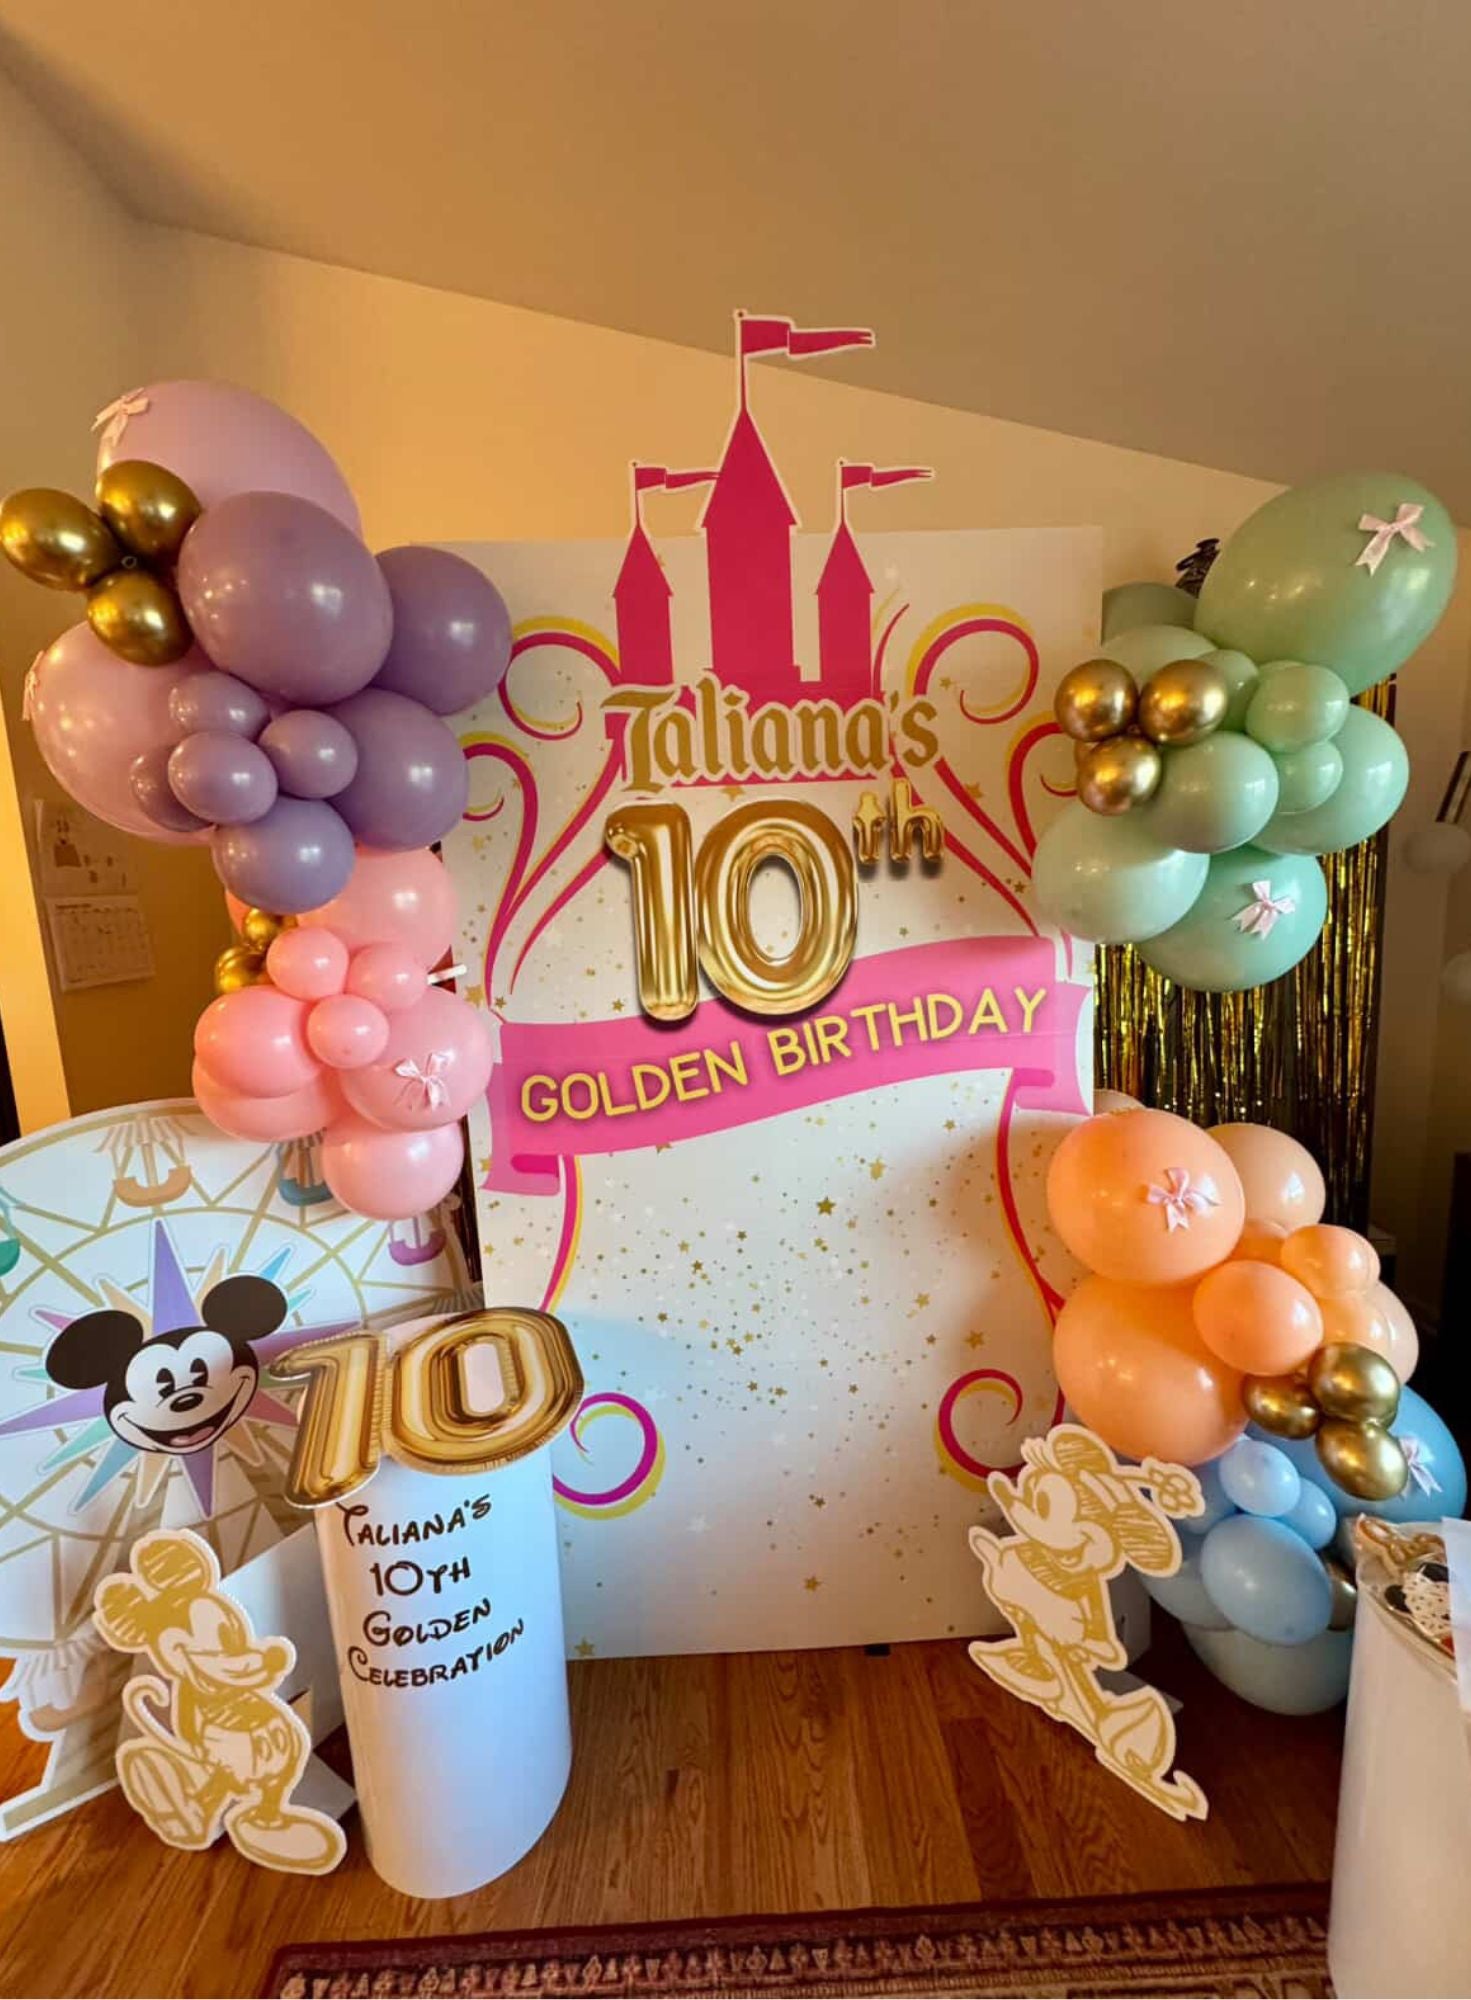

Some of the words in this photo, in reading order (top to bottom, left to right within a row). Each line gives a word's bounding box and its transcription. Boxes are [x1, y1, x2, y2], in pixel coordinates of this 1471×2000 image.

[601, 672, 940, 793] Taliana's
[520, 1040, 749, 1123] GOLDEN
[766, 986, 1047, 1077] BIRTHDAY
[268, 1306, 585, 1509] 10
[362, 1597, 492, 1648] GOLDEN
[369, 1556, 471, 1597] 10TH
[346, 1617, 526, 1689] CELEBRATION
